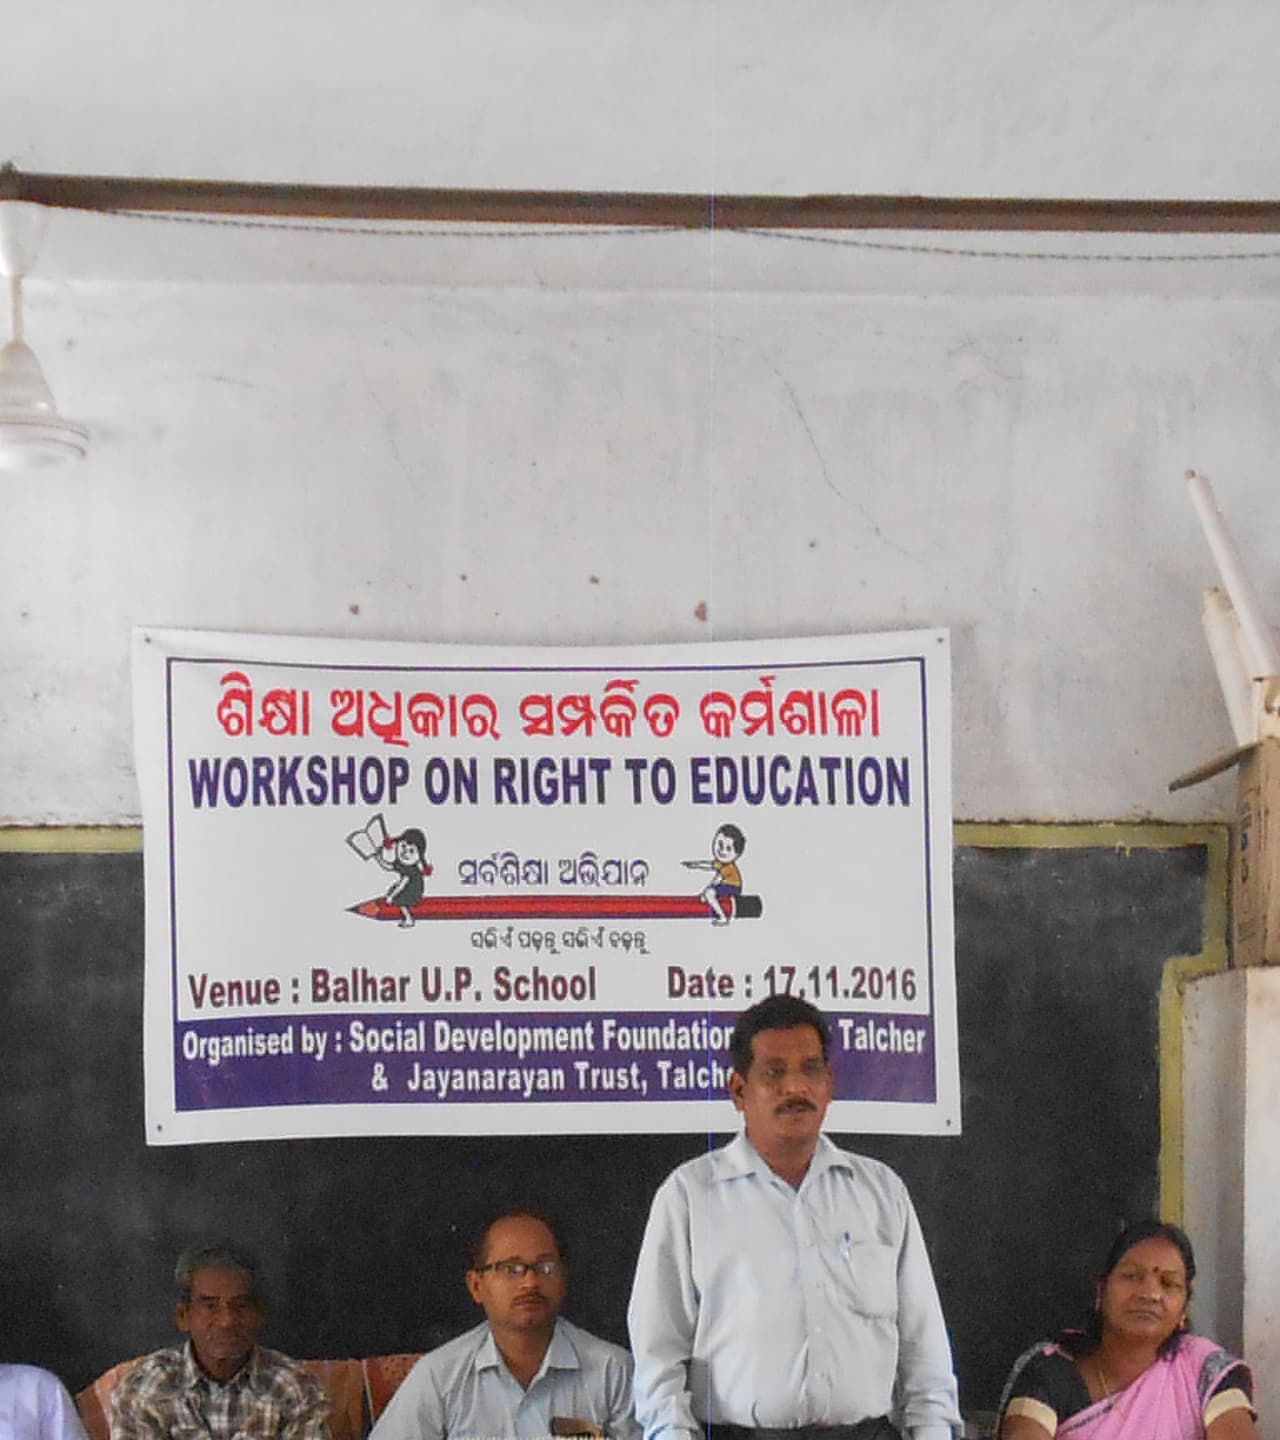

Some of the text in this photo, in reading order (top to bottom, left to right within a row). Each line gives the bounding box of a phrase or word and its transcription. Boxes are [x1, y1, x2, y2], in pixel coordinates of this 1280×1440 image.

[217, 671, 311, 737] ଶିକ୍ଷା
[329, 688, 501, 748] ଅଧିକାର
[699, 675, 880, 737] କର୍ମଶାଳା
[188, 755, 911, 808] WORKSHOP ON RIGHT TO EDUCATION
[188, 973, 280, 1009] Venue
[311, 967, 411, 1003] Balhar
[421, 966, 482, 1002] U.P.
[493, 966, 596, 1002] School
[667, 965, 735, 999] Date
[763, 965, 917, 1001] 17.11.2016
[183, 1026, 294, 1067] Organised
[301, 1024, 327, 1061] by
[349, 1019, 426, 1053] Social
[434, 1019, 595, 1060] Development
[838, 1018, 926, 1053] Talcher
[371, 1062, 388, 1092] &
[407, 1062, 565, 1099] Jayanarayan
[574, 1060, 648, 1095] Trust,
